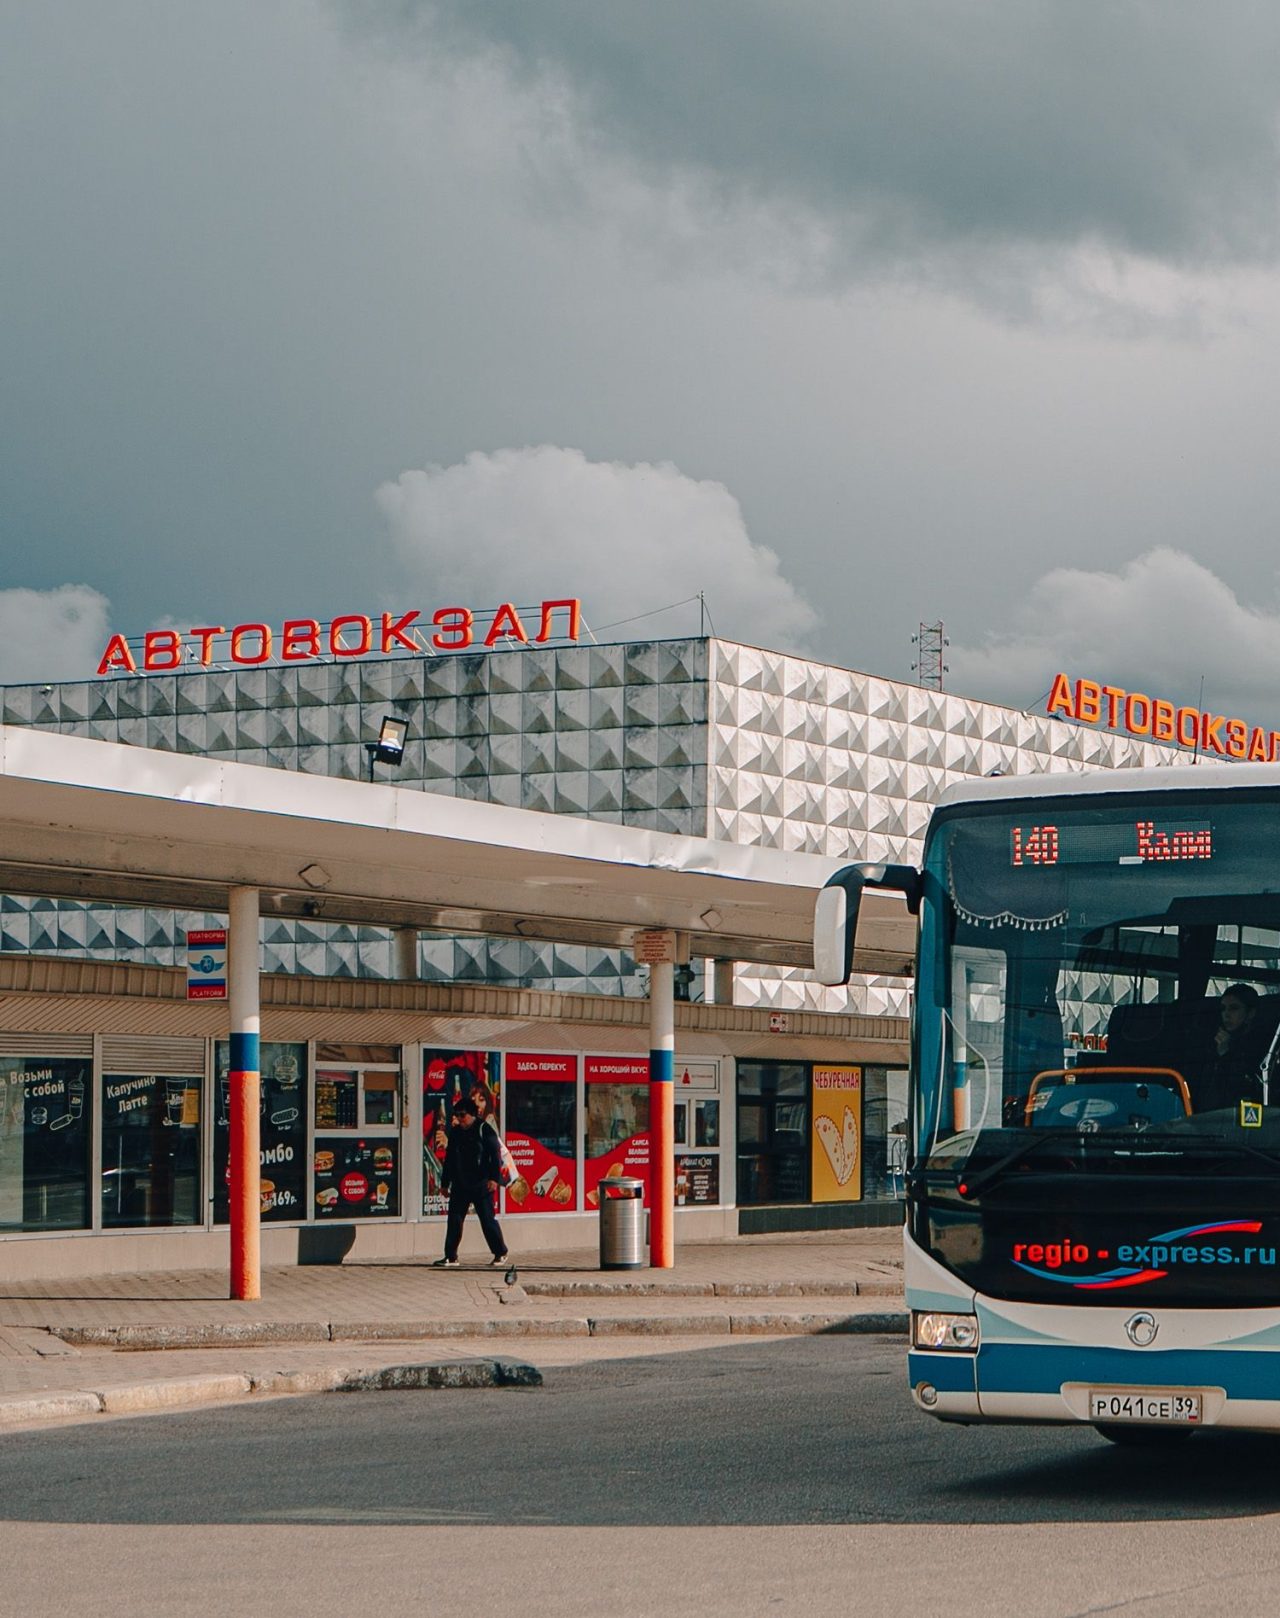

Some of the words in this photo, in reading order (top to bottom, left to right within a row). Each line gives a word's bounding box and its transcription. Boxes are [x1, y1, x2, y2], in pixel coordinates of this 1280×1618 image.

[97, 599, 580, 675] АВТОВОКЗАЛ
[1013, 826, 1058, 866] 140
[517, 1062, 538, 1071] ЗДЕСЬ
[539, 1062, 567, 1071] ПЕРЕКУС
[590, 1065, 598, 1073] НА
[600, 1064, 630, 1074] ХОРОШИЙ
[10, 1069, 53, 1085] Возьми
[814, 1071, 860, 1089] ЧЕБУРЕЧНАЯ
[32, 1080, 65, 1097] собой
[106, 1076, 156, 1099] Капучино
[118, 1095, 148, 1114] Латте
[260, 1143, 293, 1165] омбо
[1175, 1397, 1194, 1413] 39
